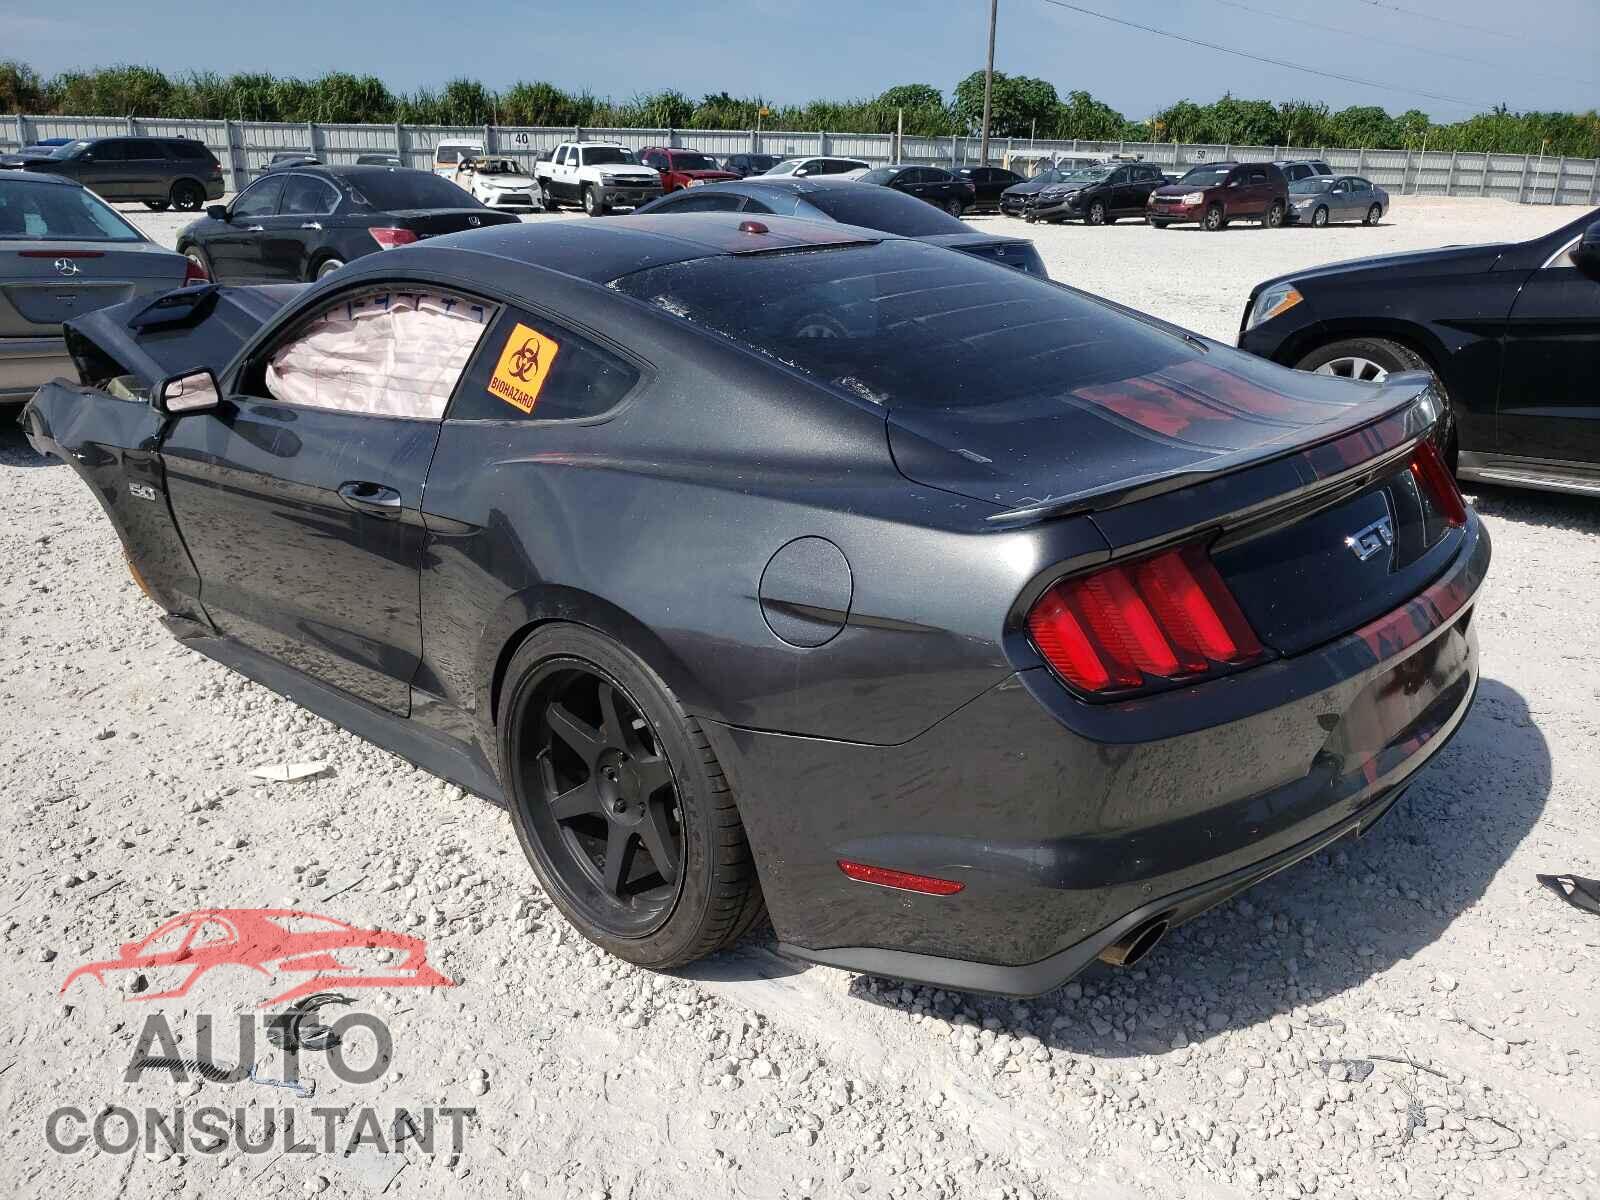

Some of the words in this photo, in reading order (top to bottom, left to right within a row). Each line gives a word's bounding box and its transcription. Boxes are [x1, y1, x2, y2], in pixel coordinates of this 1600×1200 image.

[515, 133, 529, 145] 40
[491, 376, 535, 409] BIOHAZARD
[1344, 515, 1393, 561] GT
